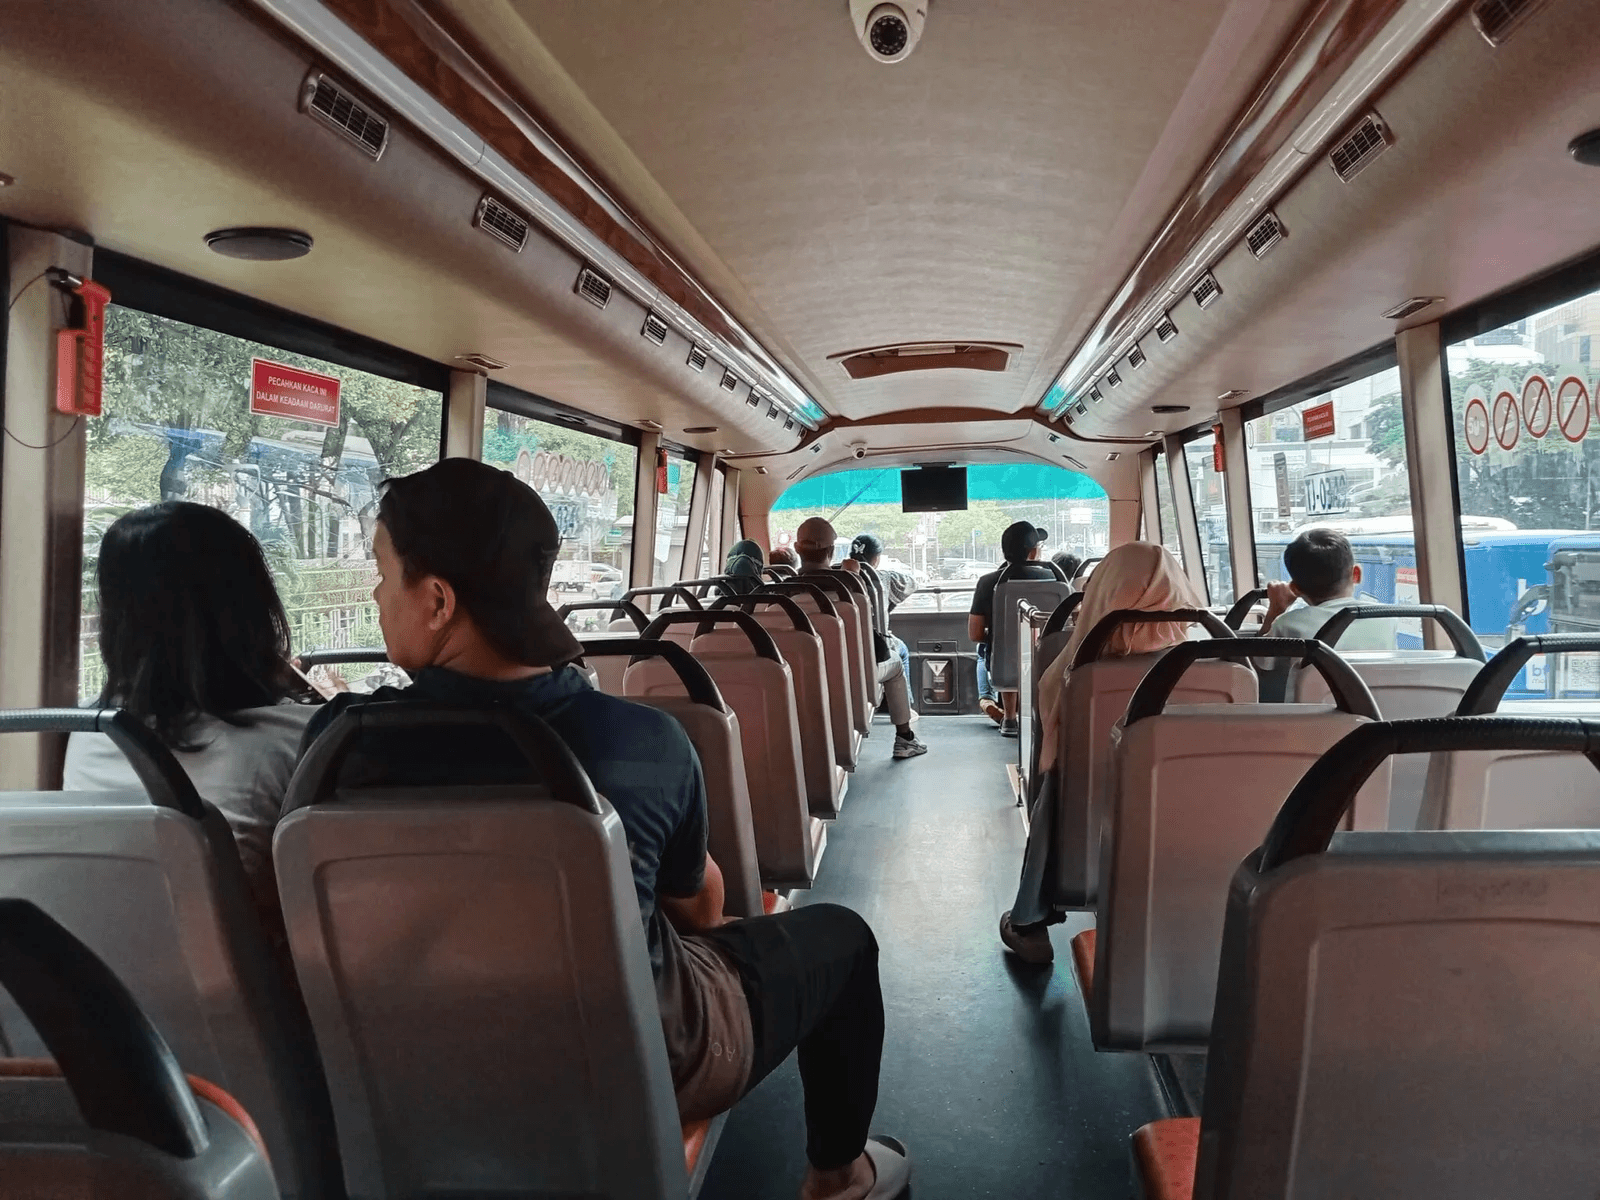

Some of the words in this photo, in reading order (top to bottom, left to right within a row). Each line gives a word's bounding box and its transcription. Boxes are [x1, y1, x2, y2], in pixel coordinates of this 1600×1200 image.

[268, 376, 302, 391] PECAHKAN
[303, 382, 319, 395] KACA
[256, 391, 279, 403] DALAM
[280, 396, 309, 409] KEADAAN
[309, 401, 336, 414] DARURAT
